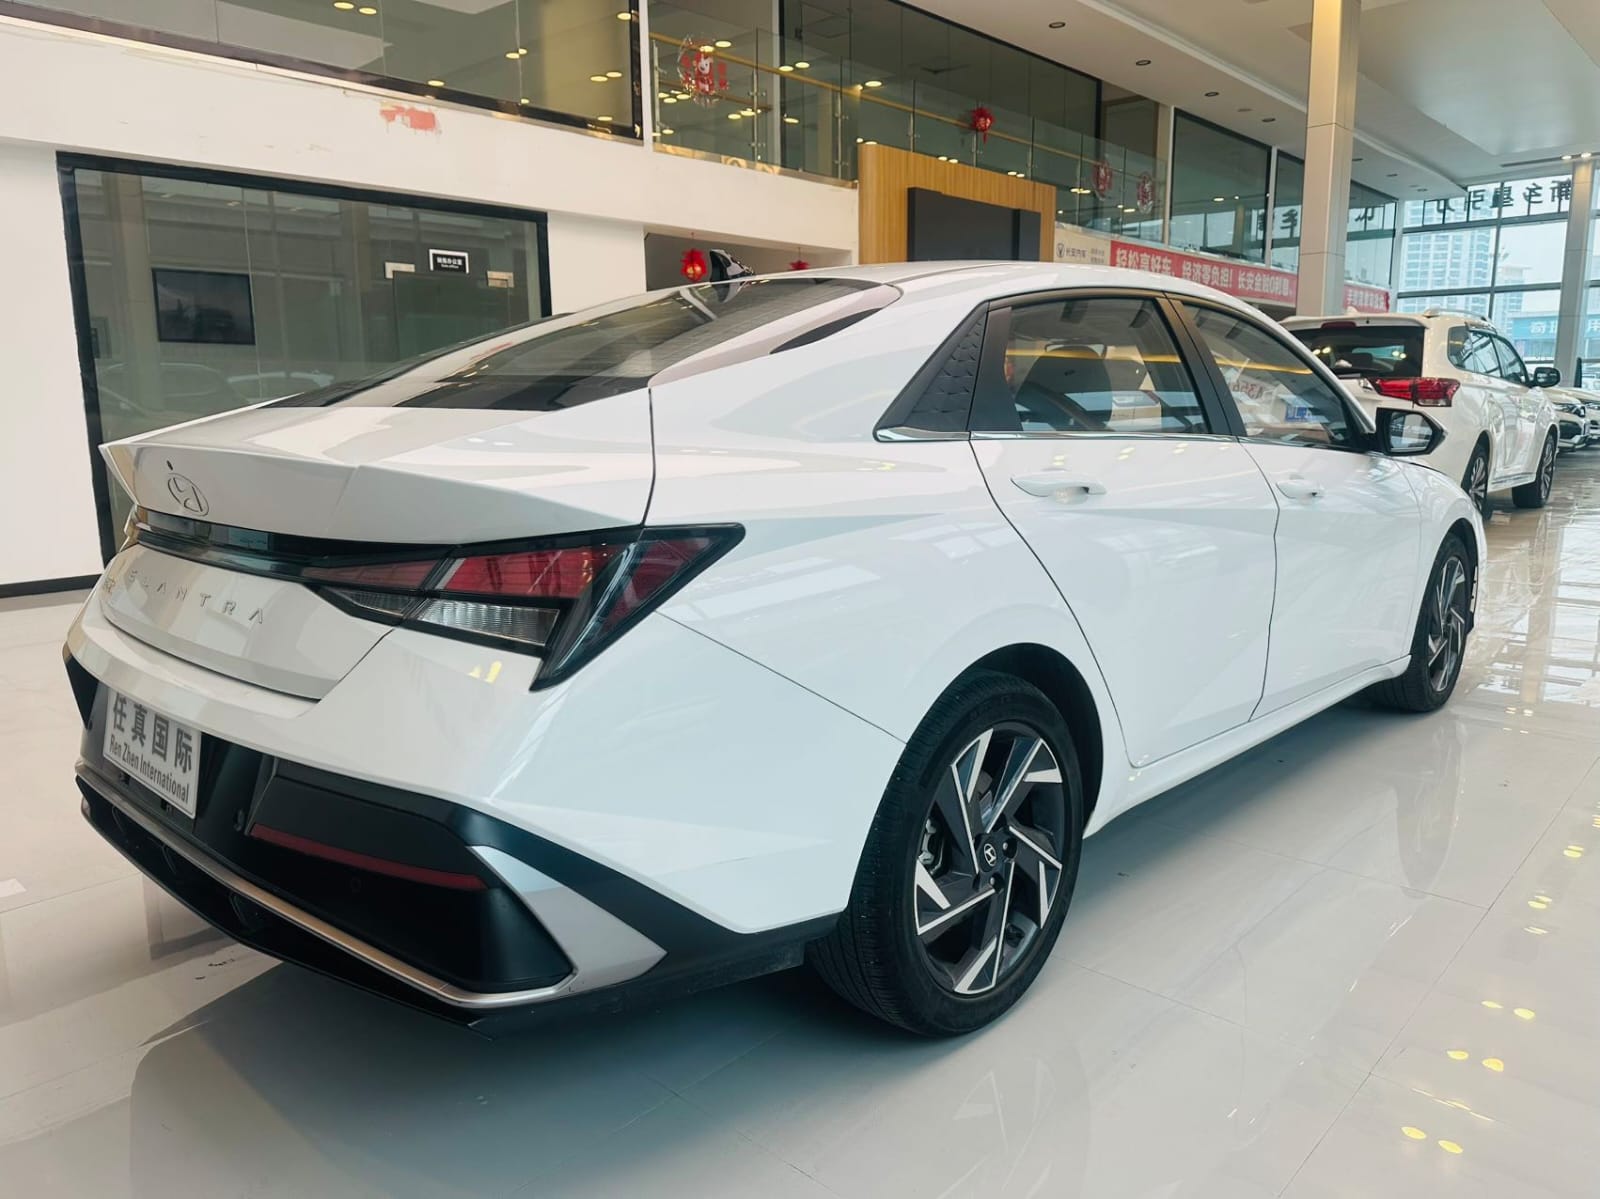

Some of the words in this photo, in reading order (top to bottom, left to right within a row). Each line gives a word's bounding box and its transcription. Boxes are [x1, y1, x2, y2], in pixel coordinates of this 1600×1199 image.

[129, 570, 264, 624] ELANTRA
[113, 691, 193, 774] 任真国际
[109, 734, 122, 755] Ren
[122, 741, 139, 770] Zhen
[140, 754, 190, 804] International
